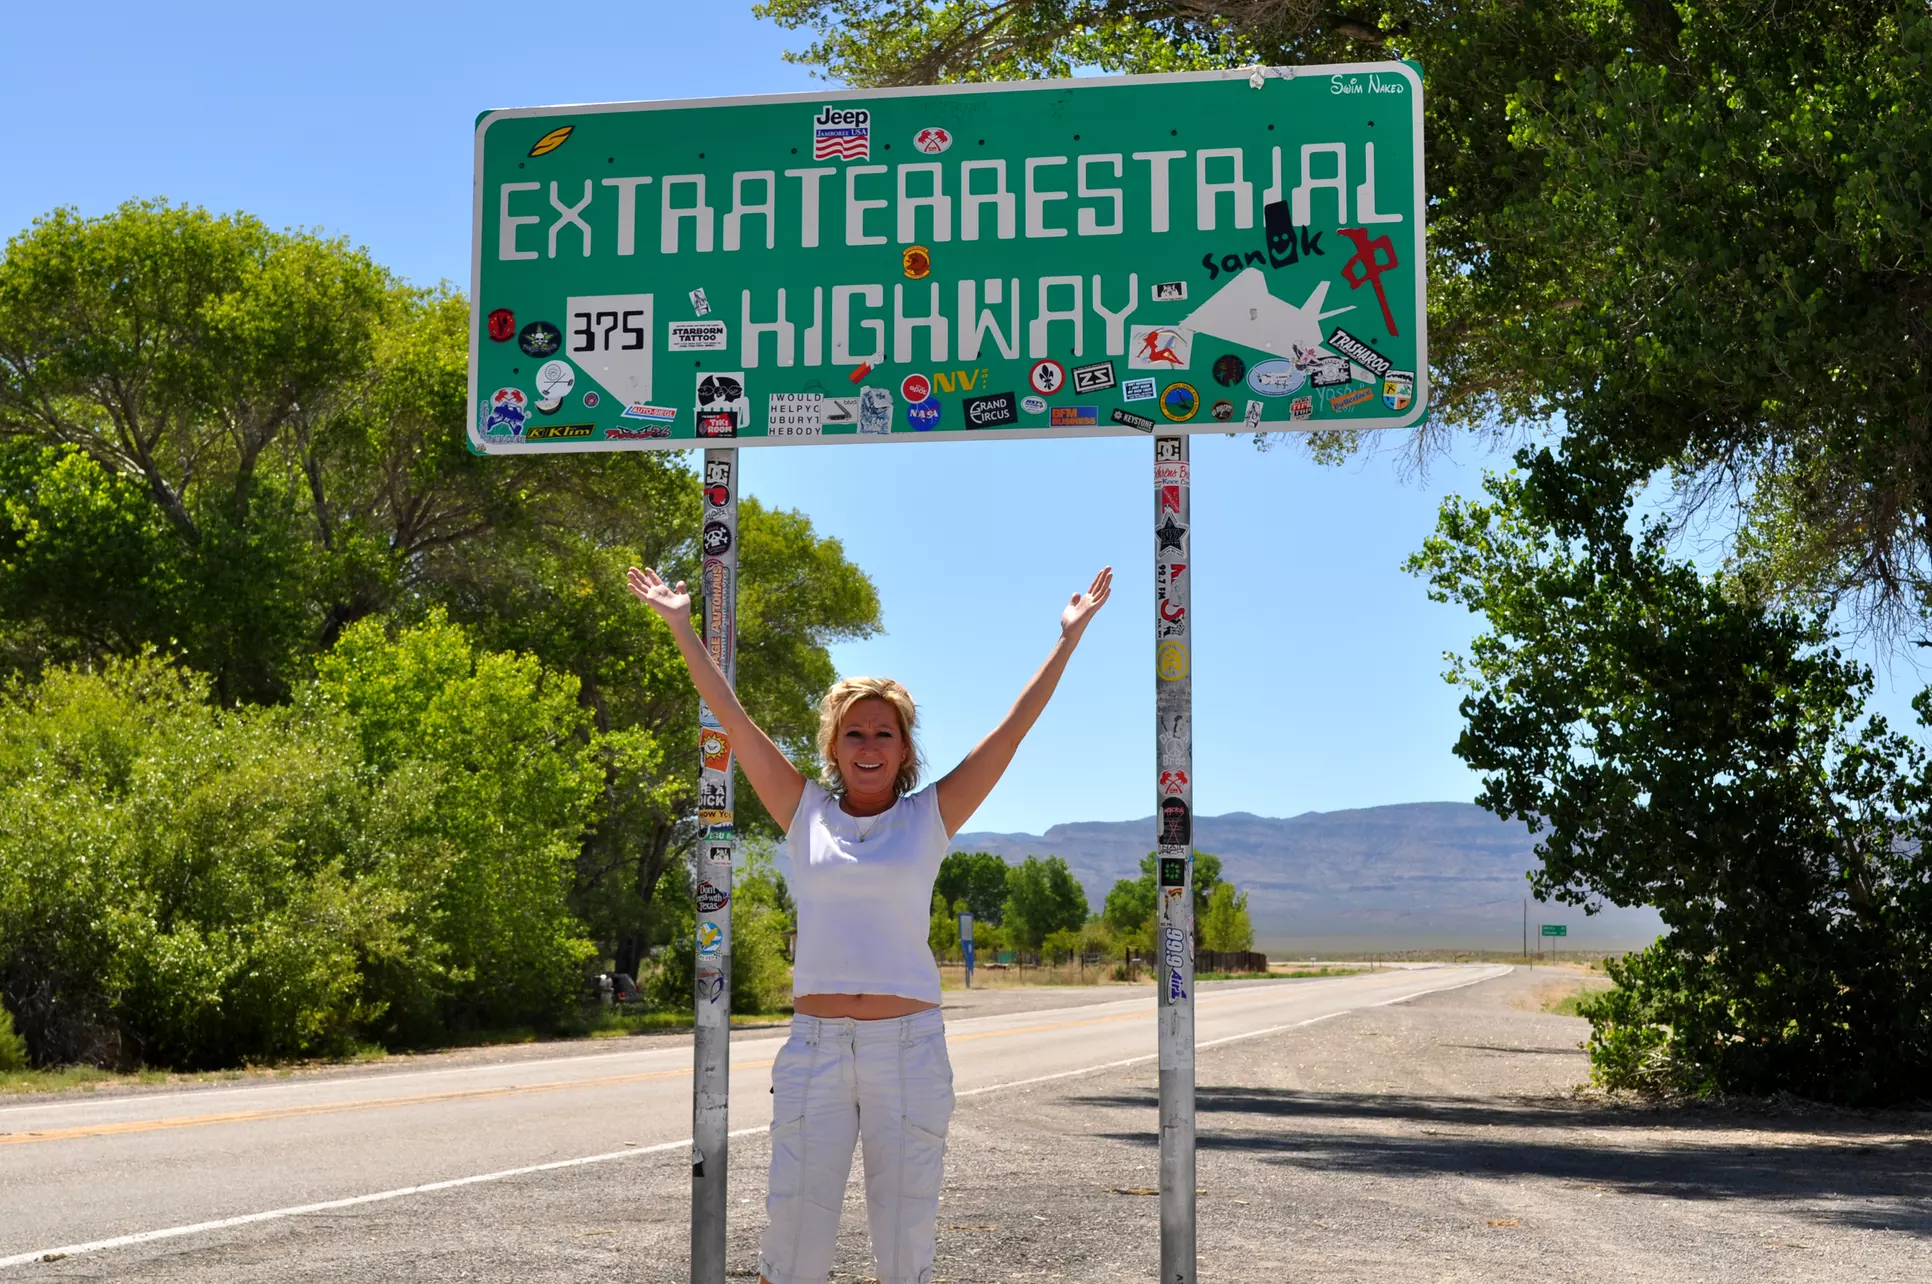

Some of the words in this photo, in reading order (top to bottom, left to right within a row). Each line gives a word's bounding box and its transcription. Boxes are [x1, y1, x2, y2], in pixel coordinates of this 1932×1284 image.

[816, 107, 868, 128] Jeep
[851, 128, 867, 136] USA
[499, 142, 1404, 261] EXTRATERRESTRIAL
[741, 272, 1139, 369] HIGHWAY
[573, 310, 644, 352] 375
[672, 327, 723, 336] STARBORN
[679, 334, 716, 342] TATTOO
[1329, 329, 1390, 373] TRASHAROO
[631, 407, 674, 416] AUTO-SIEGL
[970, 398, 1008, 414] GRAND
[1051, 408, 1078, 418] BFM
[909, 408, 939, 419] NASA
[970, 409, 1010, 424] CIRCUS
[1051, 417, 1096, 426] BUSINESS
[1123, 413, 1154, 430] KEYSTONE
[548, 427, 590, 437] Klim
[769, 427, 821, 435] HEBODY
[1158, 564, 1167, 585] 92.7
[710, 565, 723, 635] AUTOHAUS
[1158, 587, 1166, 600] FM
[699, 901, 718, 911] Texas
[1165, 927, 1184, 969] 99.9
